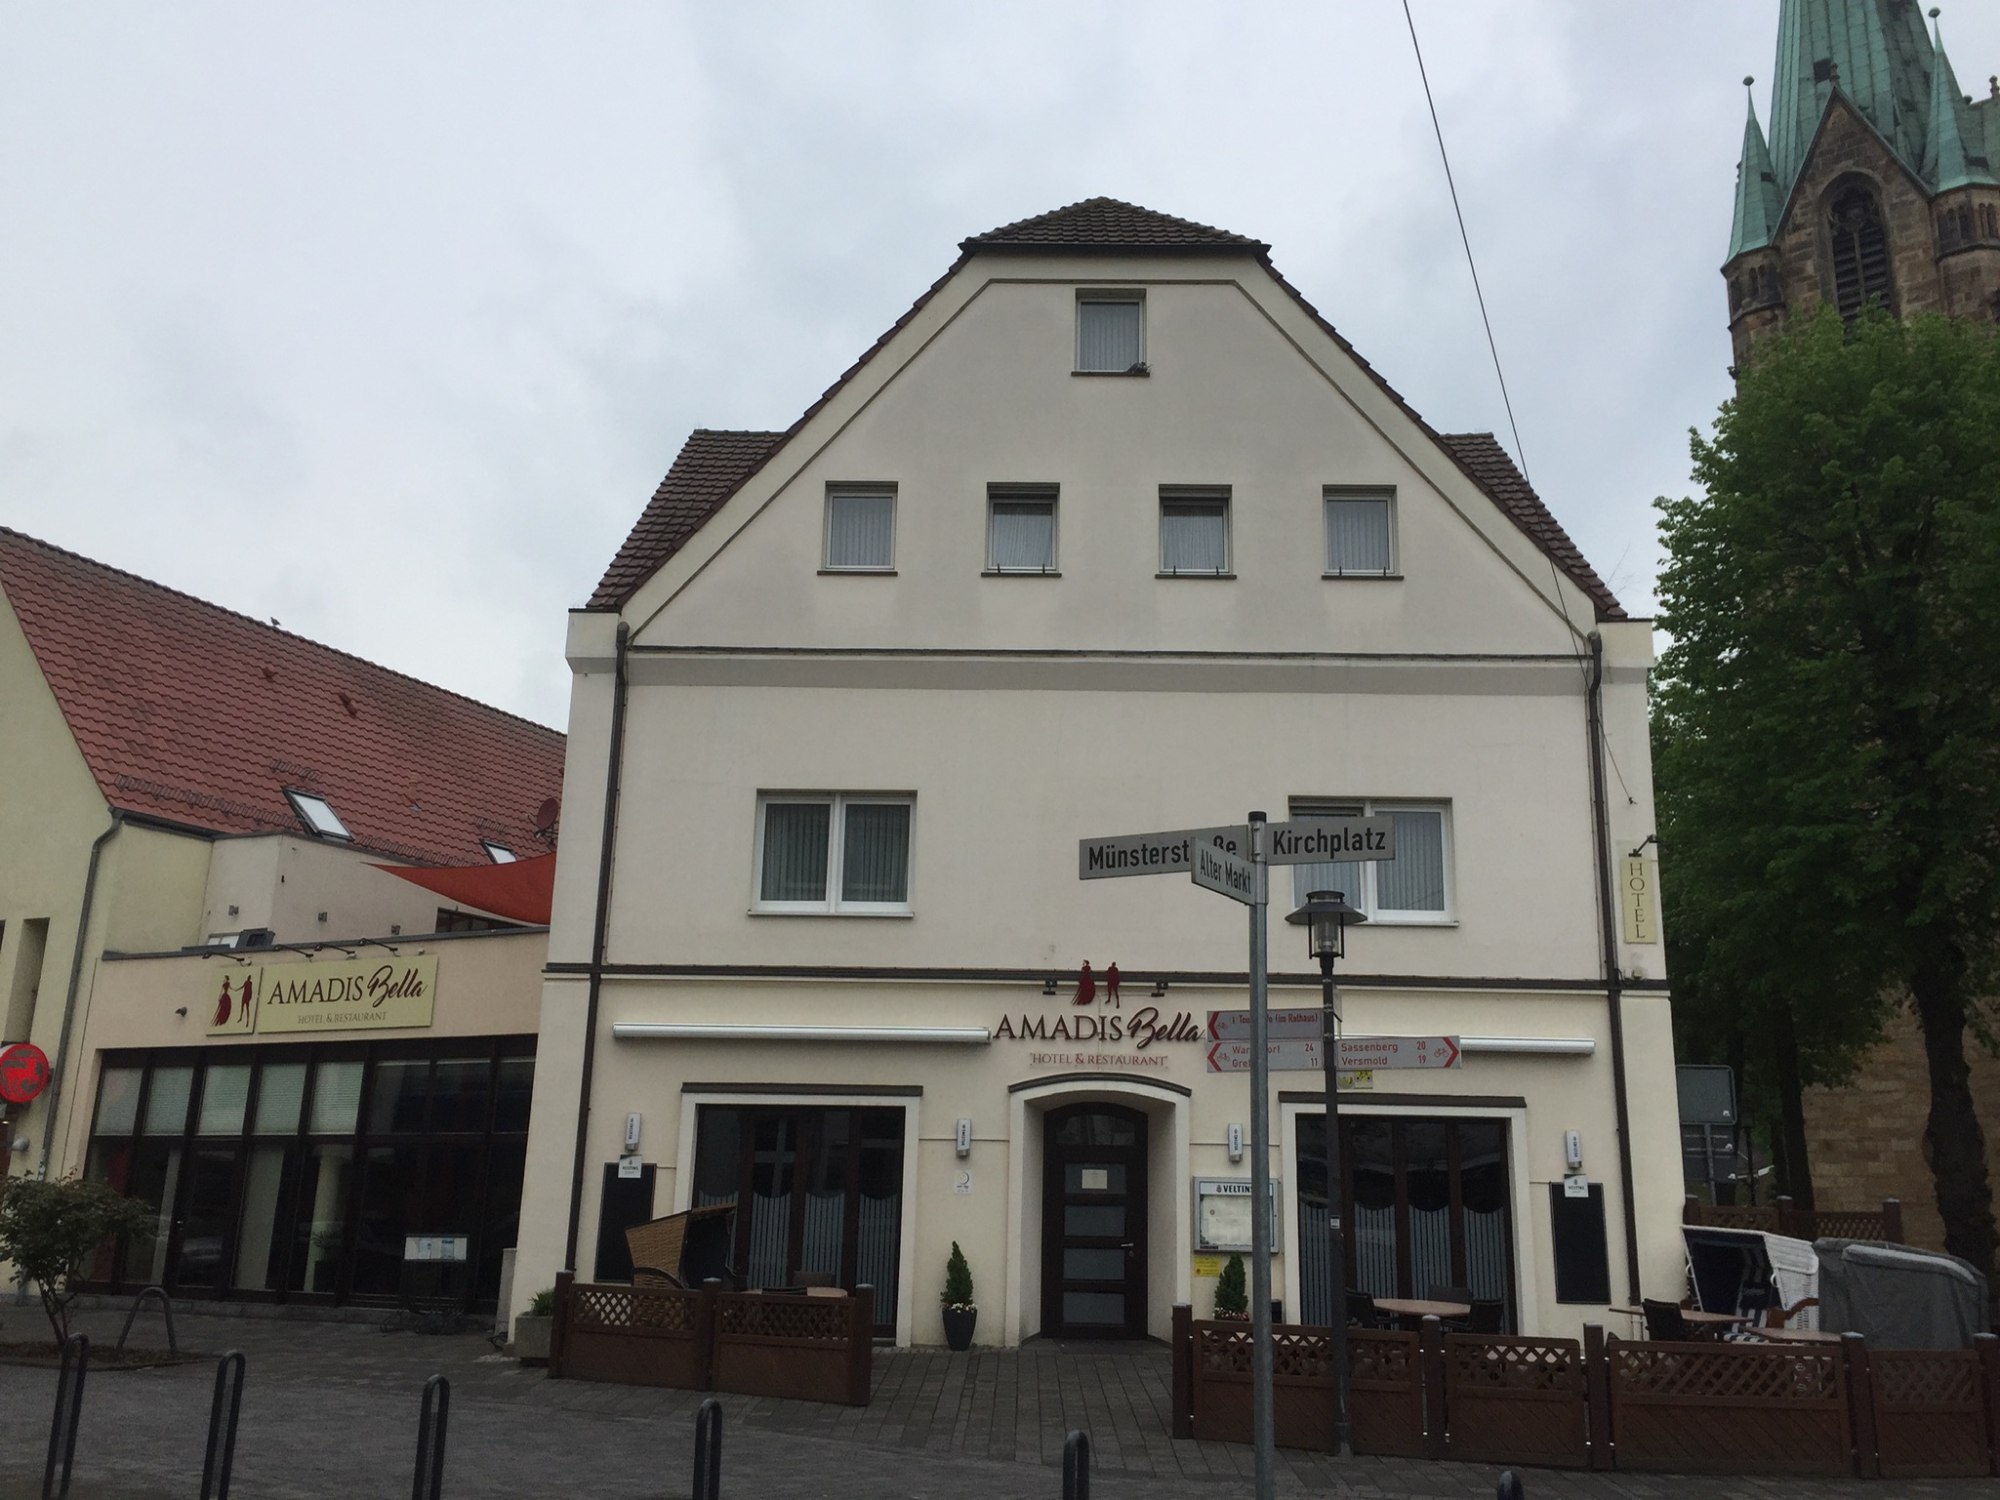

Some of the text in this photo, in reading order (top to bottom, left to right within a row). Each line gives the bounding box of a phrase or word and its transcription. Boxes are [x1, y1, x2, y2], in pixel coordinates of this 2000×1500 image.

[1088, 835, 1237, 871] Münsterstße
[1273, 827, 1386, 859] Kirchplatz
[1200, 848, 1252, 894] Alter Markt
[1629, 862, 1646, 939] HOTEL
[267, 964, 428, 1008] AMADIS Bella
[297, 1013, 323, 1025] HOTEL
[334, 1011, 387, 1023] RESTAURANT
[992, 1006, 1204, 1050] AMADIS Bella
[1341, 1041, 1426, 1053] Sassenberg 20
[1032, 1053, 1072, 1064] HOTEL
[1087, 1055, 1168, 1067] RESTAURANT
[1310, 1057, 1318, 1067] 11
[1341, 1055, 1427, 1066] Versmold 19
[1223, 1184, 1252, 1193] VELTIN
